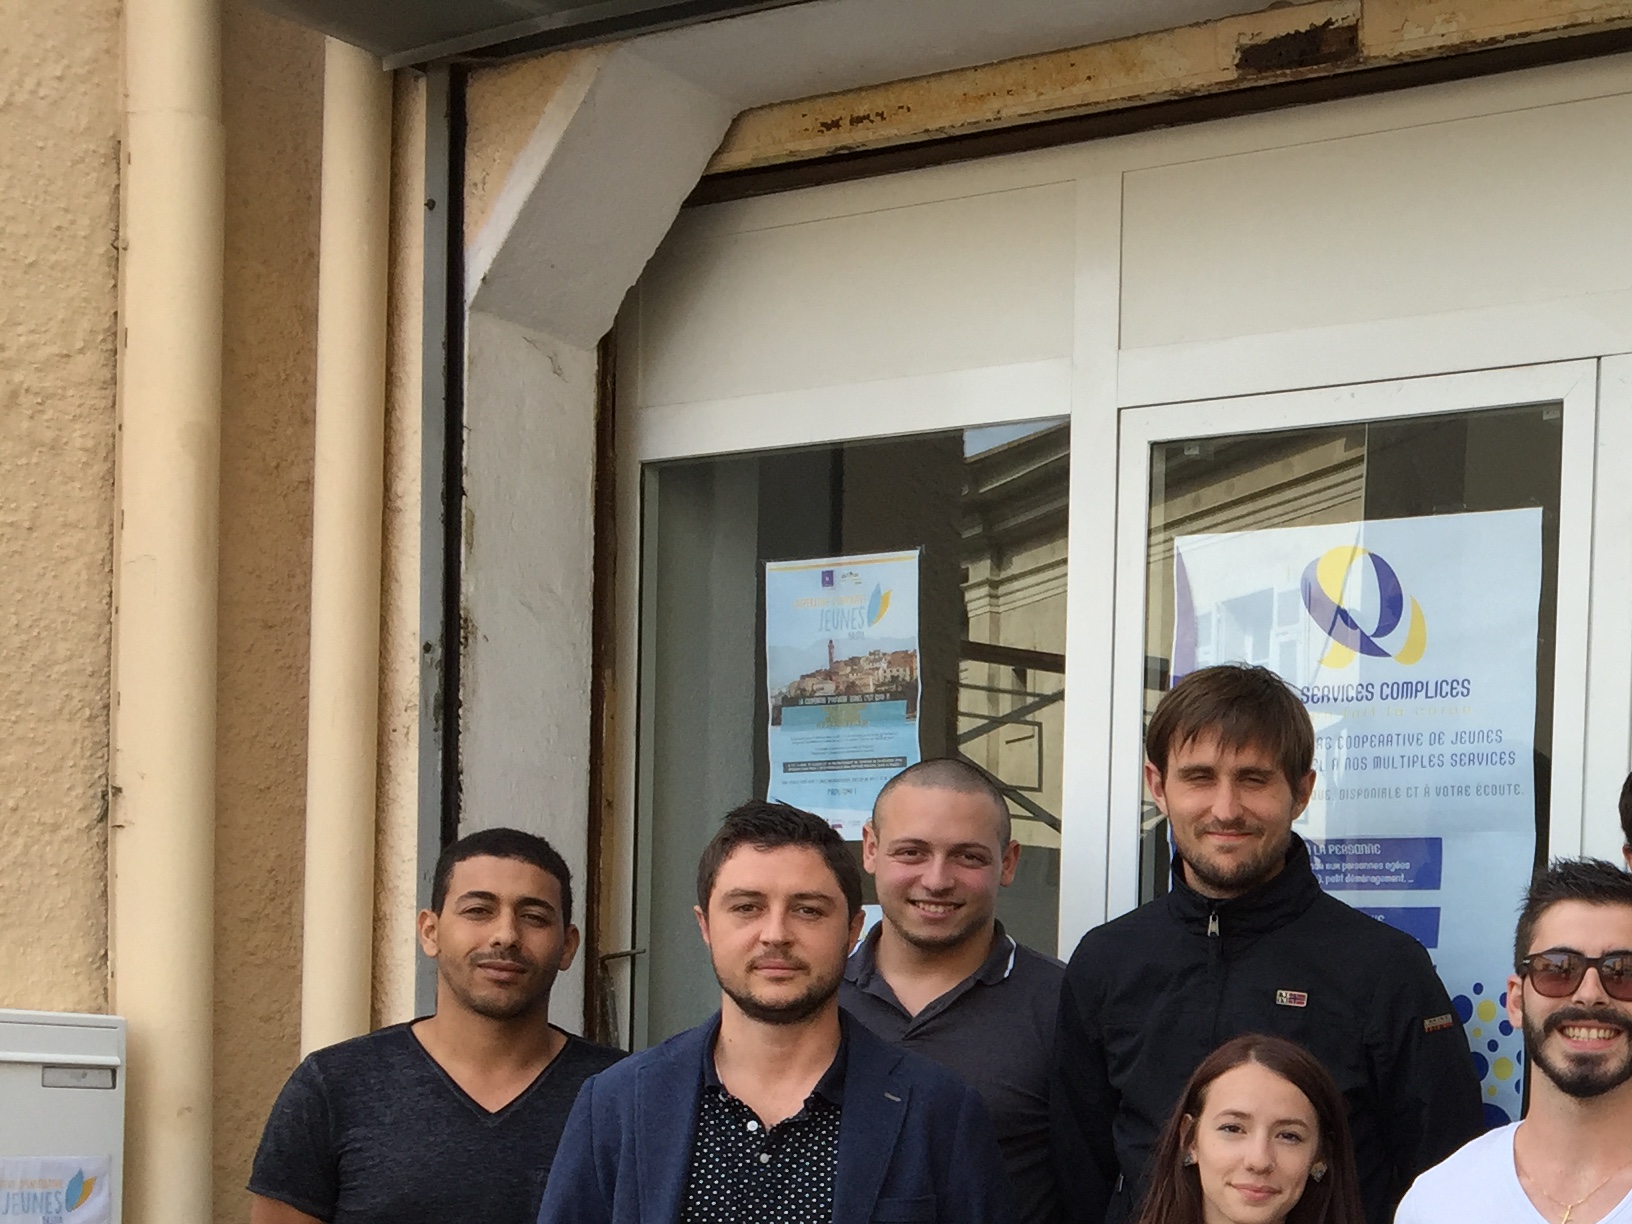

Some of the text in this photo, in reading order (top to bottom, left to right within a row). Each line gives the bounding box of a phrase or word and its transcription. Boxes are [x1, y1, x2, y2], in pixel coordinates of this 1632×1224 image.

[818, 605, 865, 632] JEUNES
[1299, 678, 1471, 704] SERVICES COMPLICES
[1337, 731, 1424, 750] COOPERATIVE
[1429, 731, 1446, 746] DE
[1451, 729, 1503, 745] JEUNES
[1344, 756, 1368, 771] NOS
[1373, 753, 1445, 770] MULTIPLES
[1450, 750, 1517, 768] SERVICES
[1339, 786, 1401, 801] DISPONIBLE
[1406, 785, 1420, 799] ET
[1424, 783, 1431, 797] À
[1435, 784, 1471, 798] VOTRE
[1313, 843, 1381, 856] LA PERSONNE
[2, 1190, 62, 1216] JEUNES
